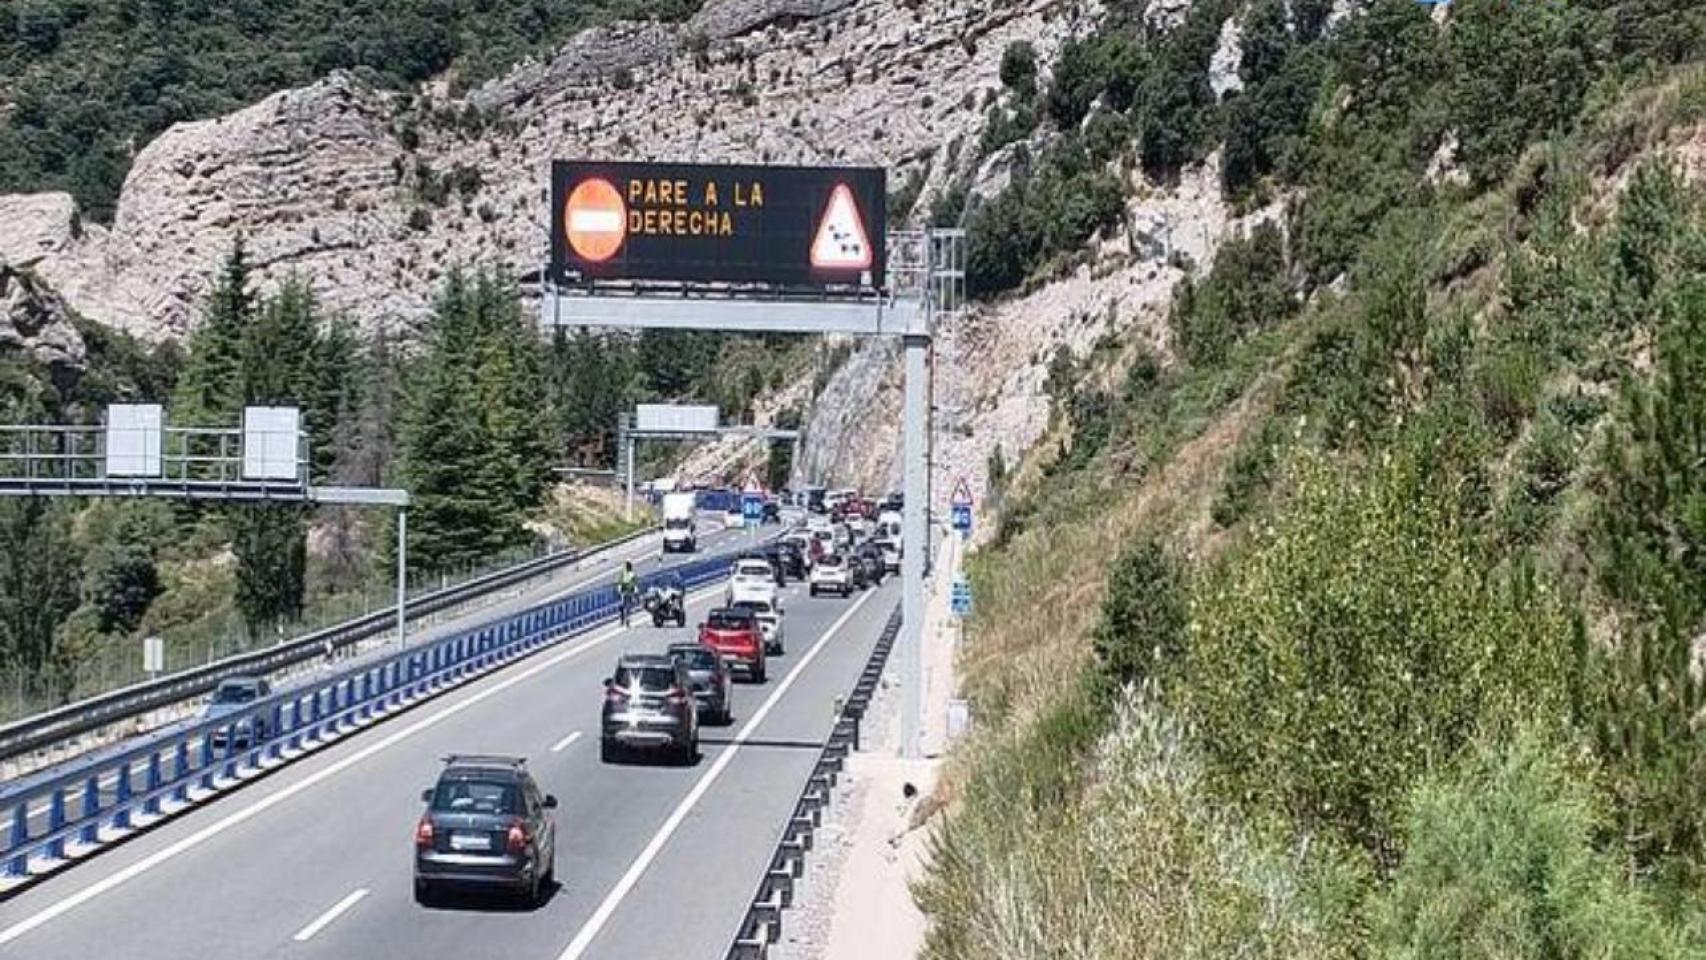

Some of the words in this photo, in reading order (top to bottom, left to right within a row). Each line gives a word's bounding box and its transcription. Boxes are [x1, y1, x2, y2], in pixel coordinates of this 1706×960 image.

[629, 179, 688, 204] PARE
[706, 181, 718, 206] A
[735, 182, 763, 206] LA
[629, 211, 732, 235] DERECHA
